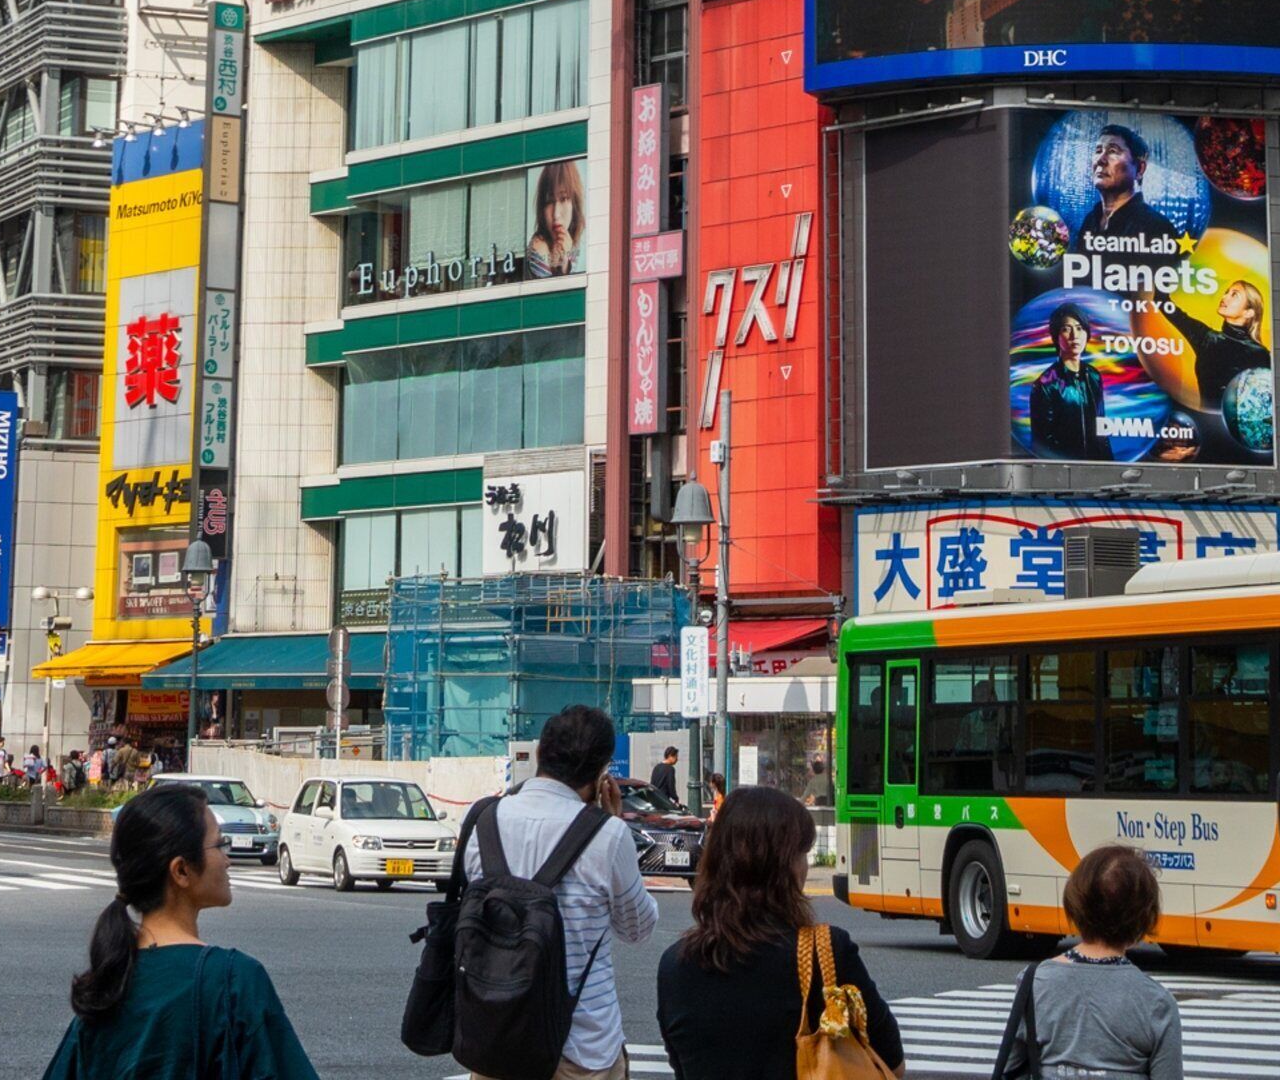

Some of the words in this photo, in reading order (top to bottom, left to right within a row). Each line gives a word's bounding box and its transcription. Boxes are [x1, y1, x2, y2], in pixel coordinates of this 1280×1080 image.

[1023, 48, 1068, 67] DHC
[220, 121, 232, 188] Euphoria
[636, 95, 658, 226] お好み焼
[115, 197, 178, 221] Matsumoto
[1083, 229, 1176, 255] teamLab
[357, 242, 517, 300] Euphoria
[1062, 253, 1219, 296] Planets
[1108, 298, 1177, 315] TOKYO
[207, 313, 219, 358] パーラー
[218, 308, 230, 353] フルーツ
[1101, 334, 1185, 357] TOYOSU
[123, 311, 183, 408] 薬
[204, 403, 215, 448] フルーツ
[1096, 415, 1194, 440] DMM.com
[484, 483, 522, 507] うなぎ
[685, 633, 699, 702] 文化村通り
[906, 803, 1000, 821] 都営バス
[1190, 814, 1220, 842] Bus
